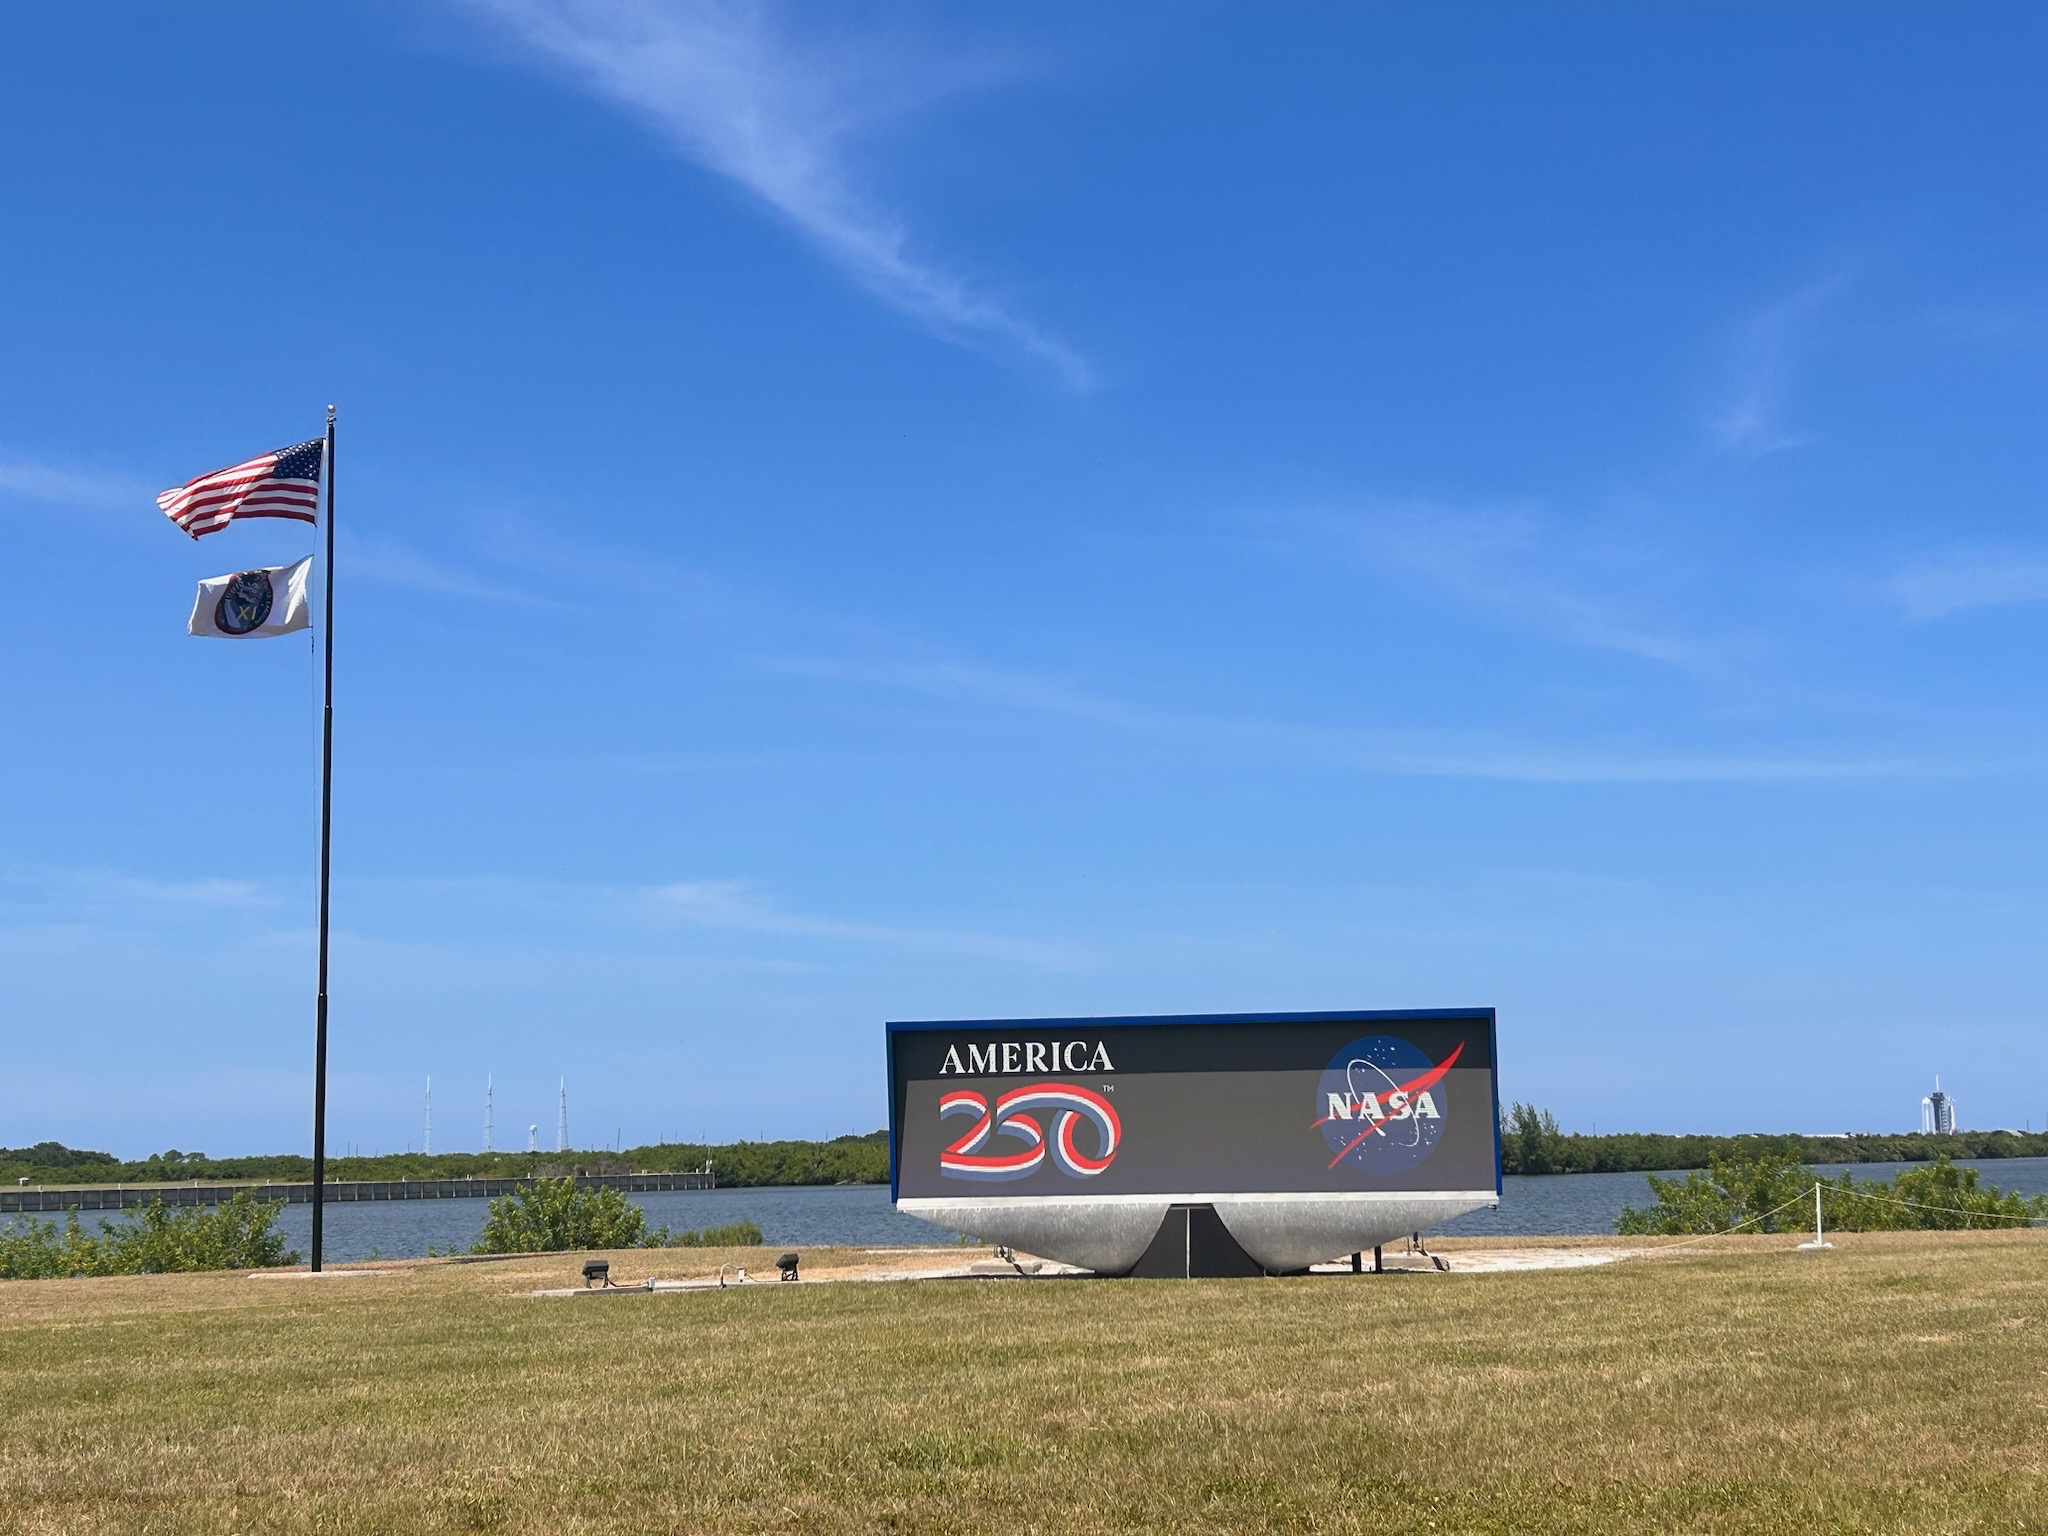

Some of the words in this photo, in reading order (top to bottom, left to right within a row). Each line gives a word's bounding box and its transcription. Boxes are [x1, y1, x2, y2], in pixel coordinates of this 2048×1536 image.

[939, 1041, 1115, 1074] AMERICA
[1327, 1091, 1441, 1120] NASA
[940, 1082, 1121, 1182] 250
